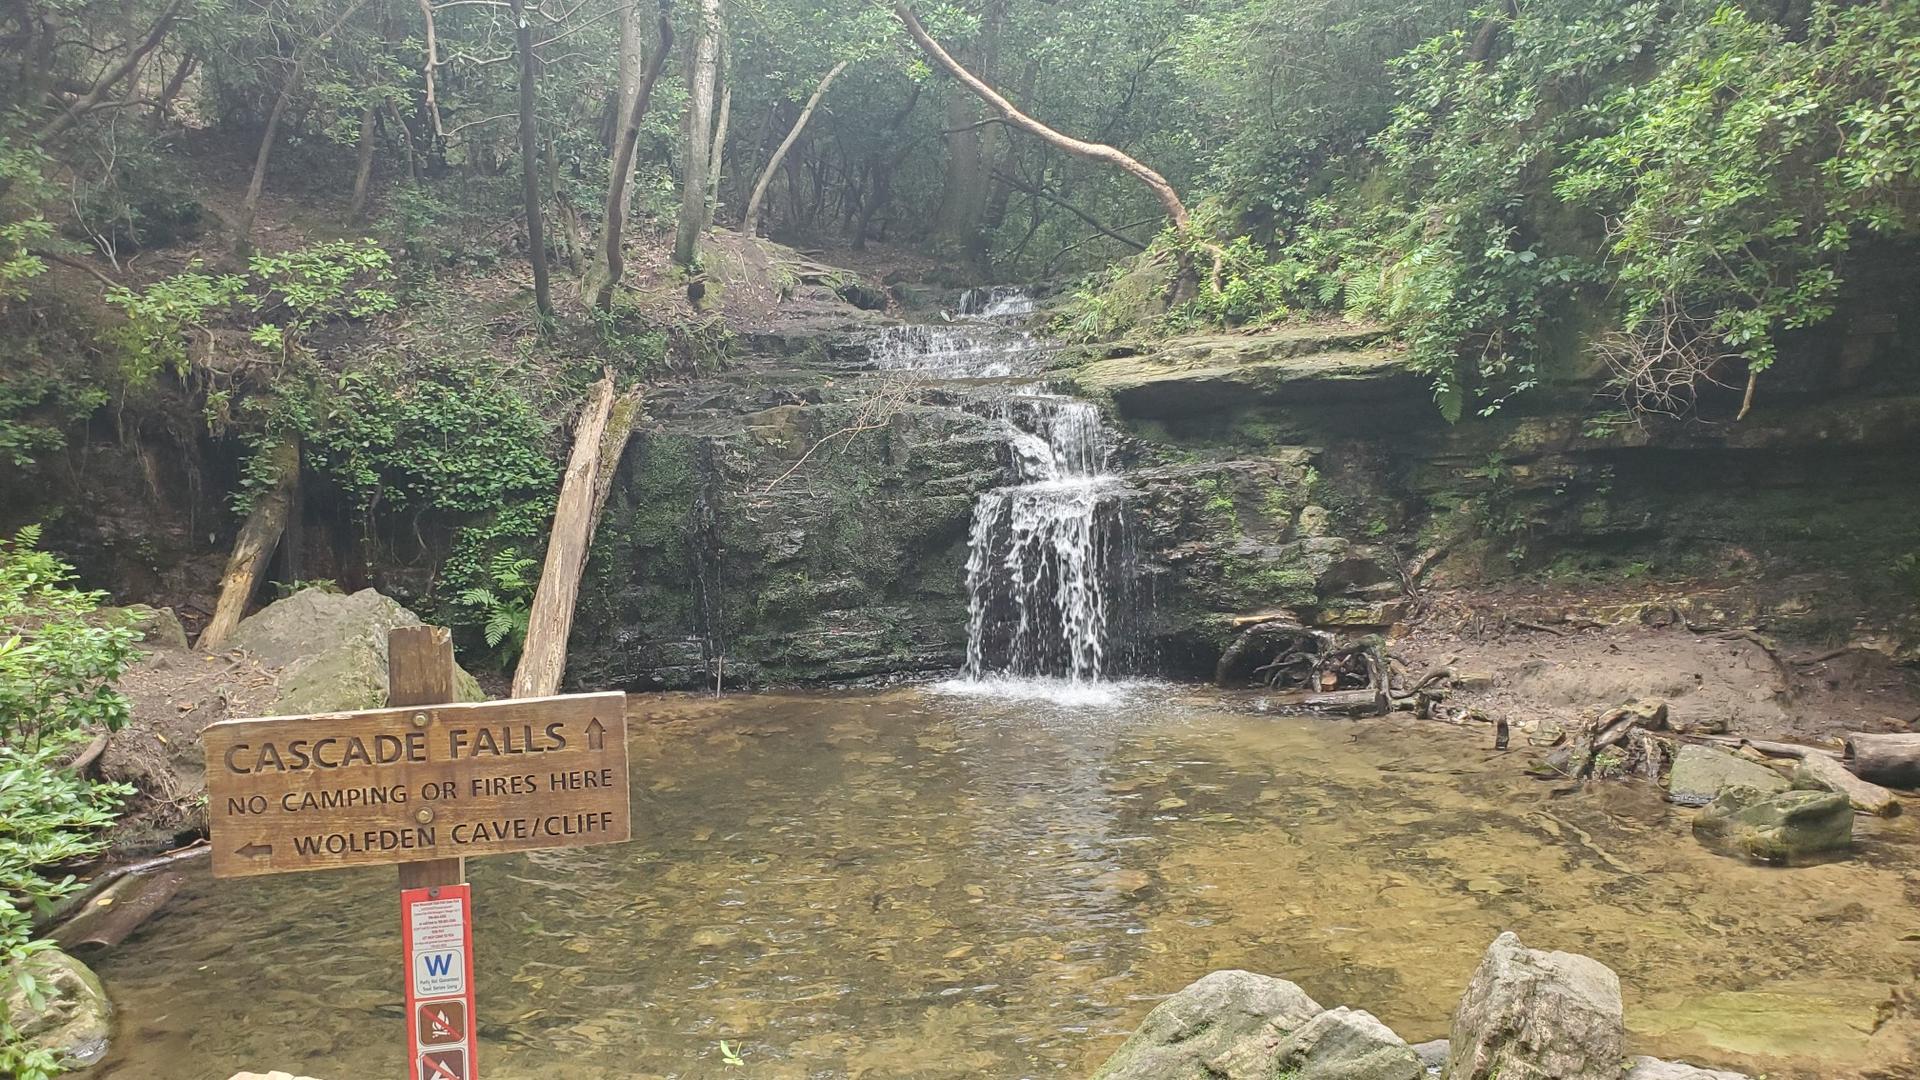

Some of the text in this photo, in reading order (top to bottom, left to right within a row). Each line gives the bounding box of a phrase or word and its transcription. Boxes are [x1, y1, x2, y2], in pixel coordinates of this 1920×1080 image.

[224, 722, 566, 774] CASCADE FALLS
[228, 768, 613, 815] NO CAMPING OR FIRES HERE
[294, 811, 613, 856] WOLFDEN CAVE/CLIFF
[424, 953, 452, 976] W
